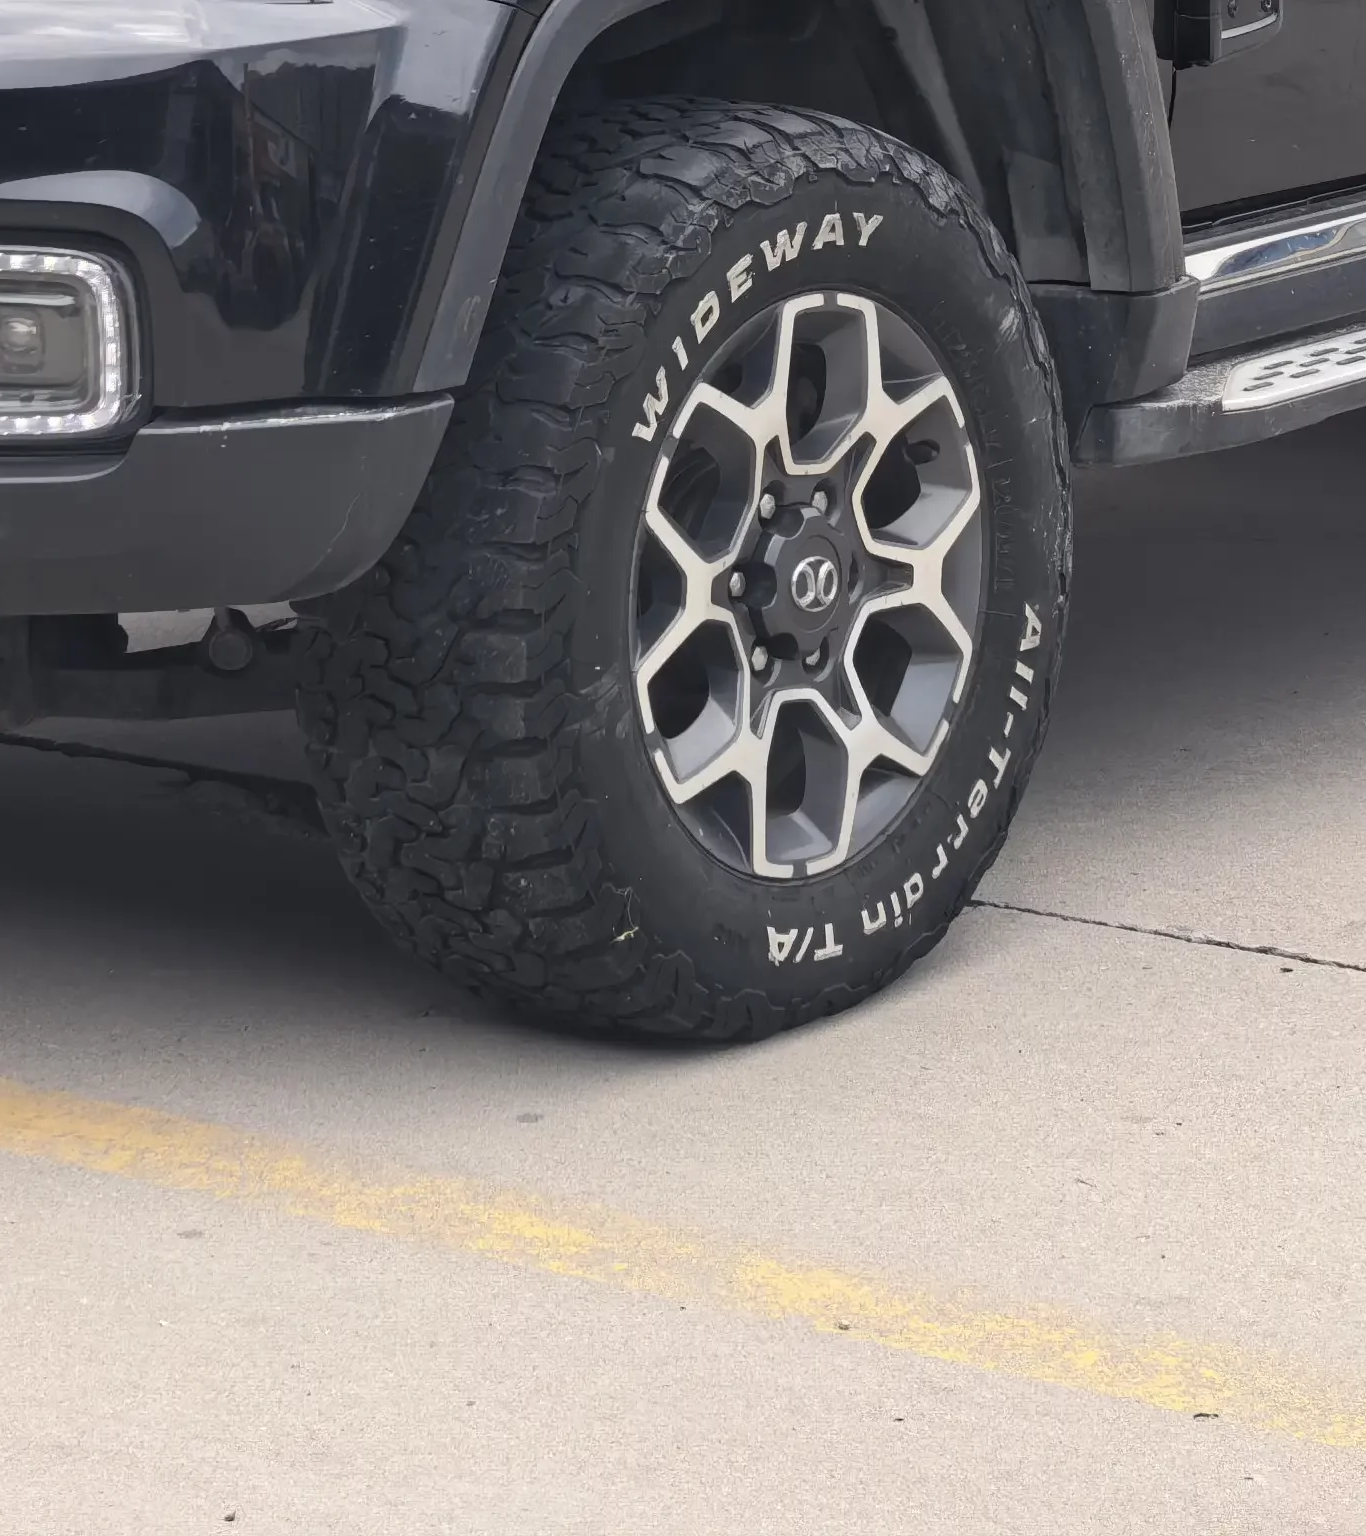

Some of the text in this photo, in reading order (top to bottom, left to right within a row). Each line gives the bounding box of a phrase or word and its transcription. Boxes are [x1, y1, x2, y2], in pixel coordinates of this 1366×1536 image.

[631, 211, 884, 442] WIDEWAY
[860, 601, 1042, 936] All-Terrain
[766, 921, 844, 966] T/A
